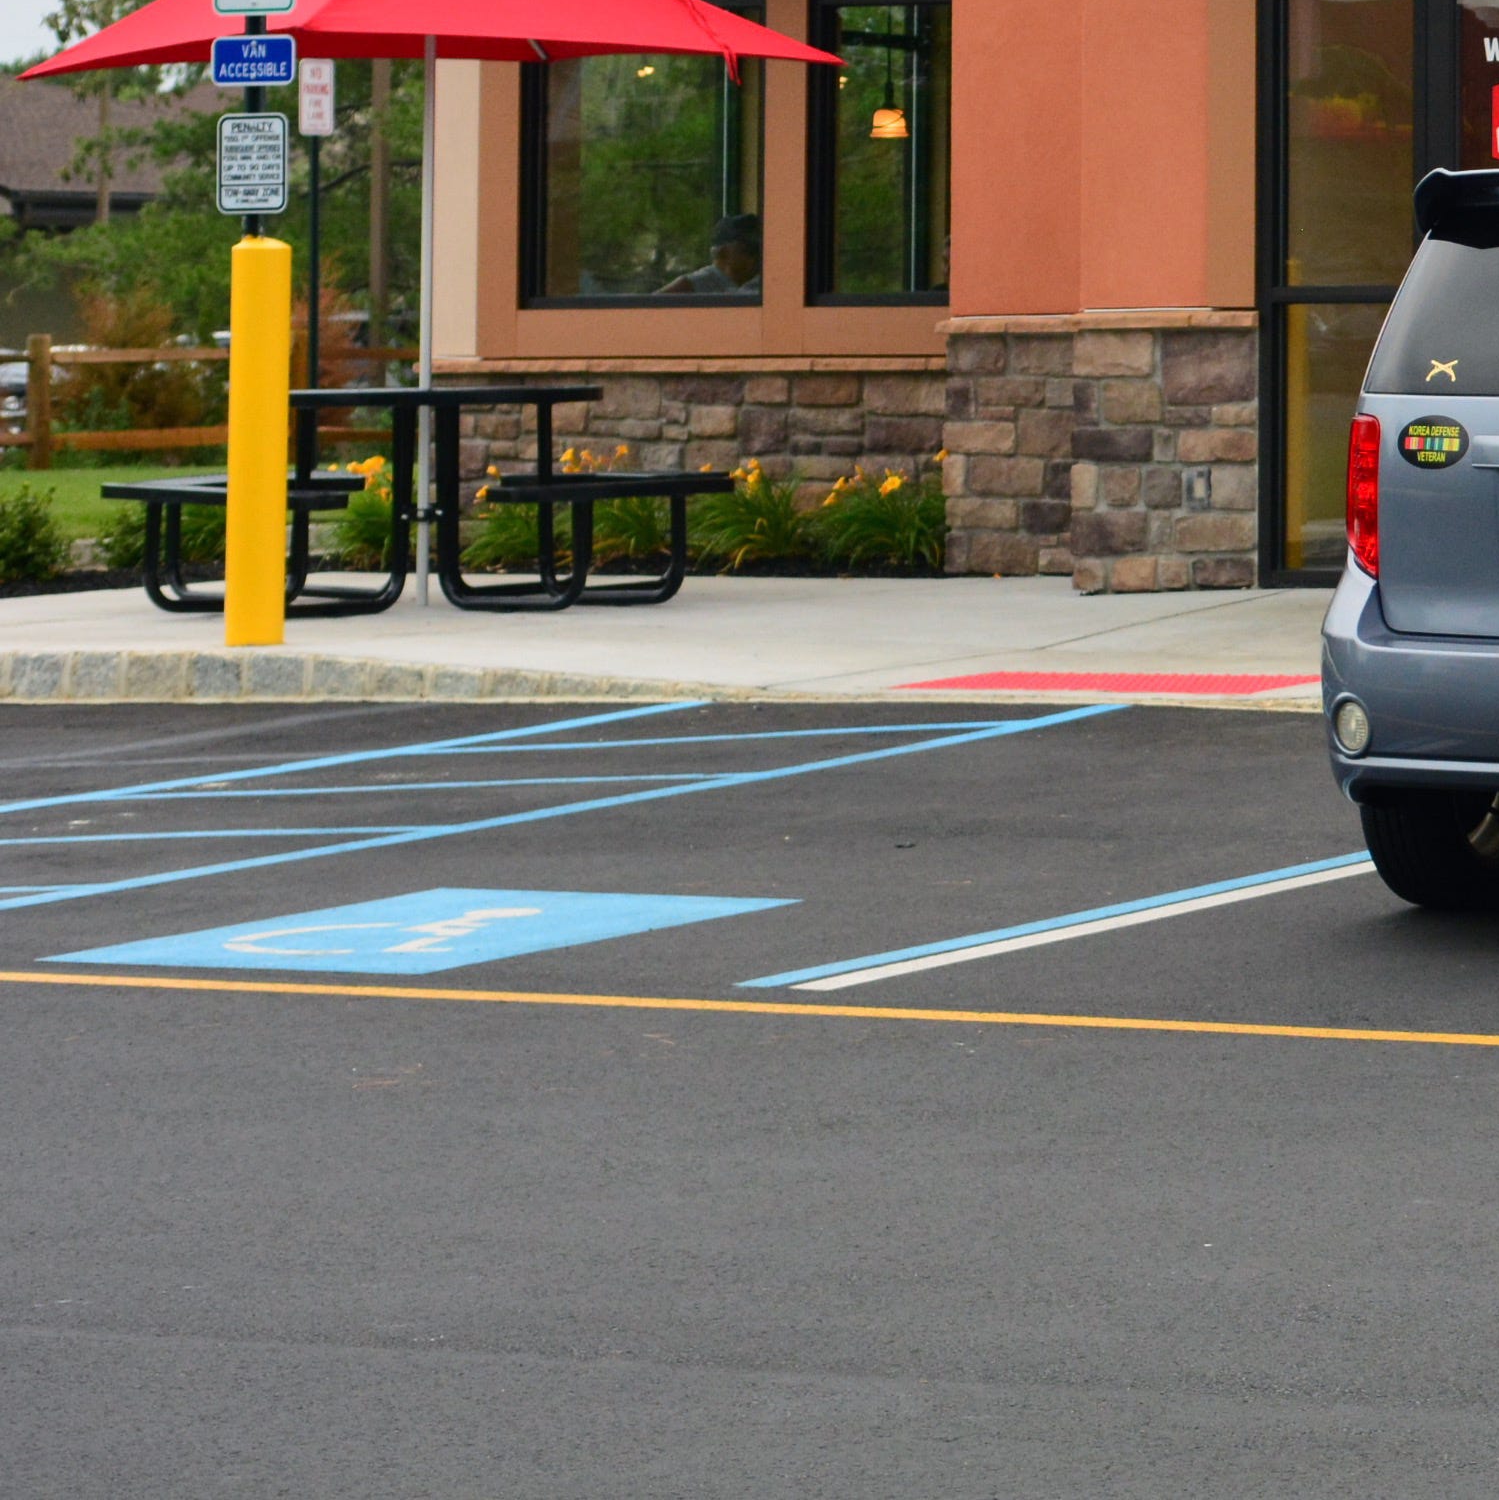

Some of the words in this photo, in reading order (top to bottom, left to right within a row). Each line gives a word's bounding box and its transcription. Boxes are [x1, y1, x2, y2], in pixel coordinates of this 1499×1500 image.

[241, 43, 267, 59] VAN
[219, 61, 288, 78] ACCESSIBLE
[231, 122, 273, 133] PENALTY
[1408, 425, 1430, 436] KOREA
[1430, 425, 1460, 437] DEFENSE
[1417, 451, 1446, 463] VETERAN
